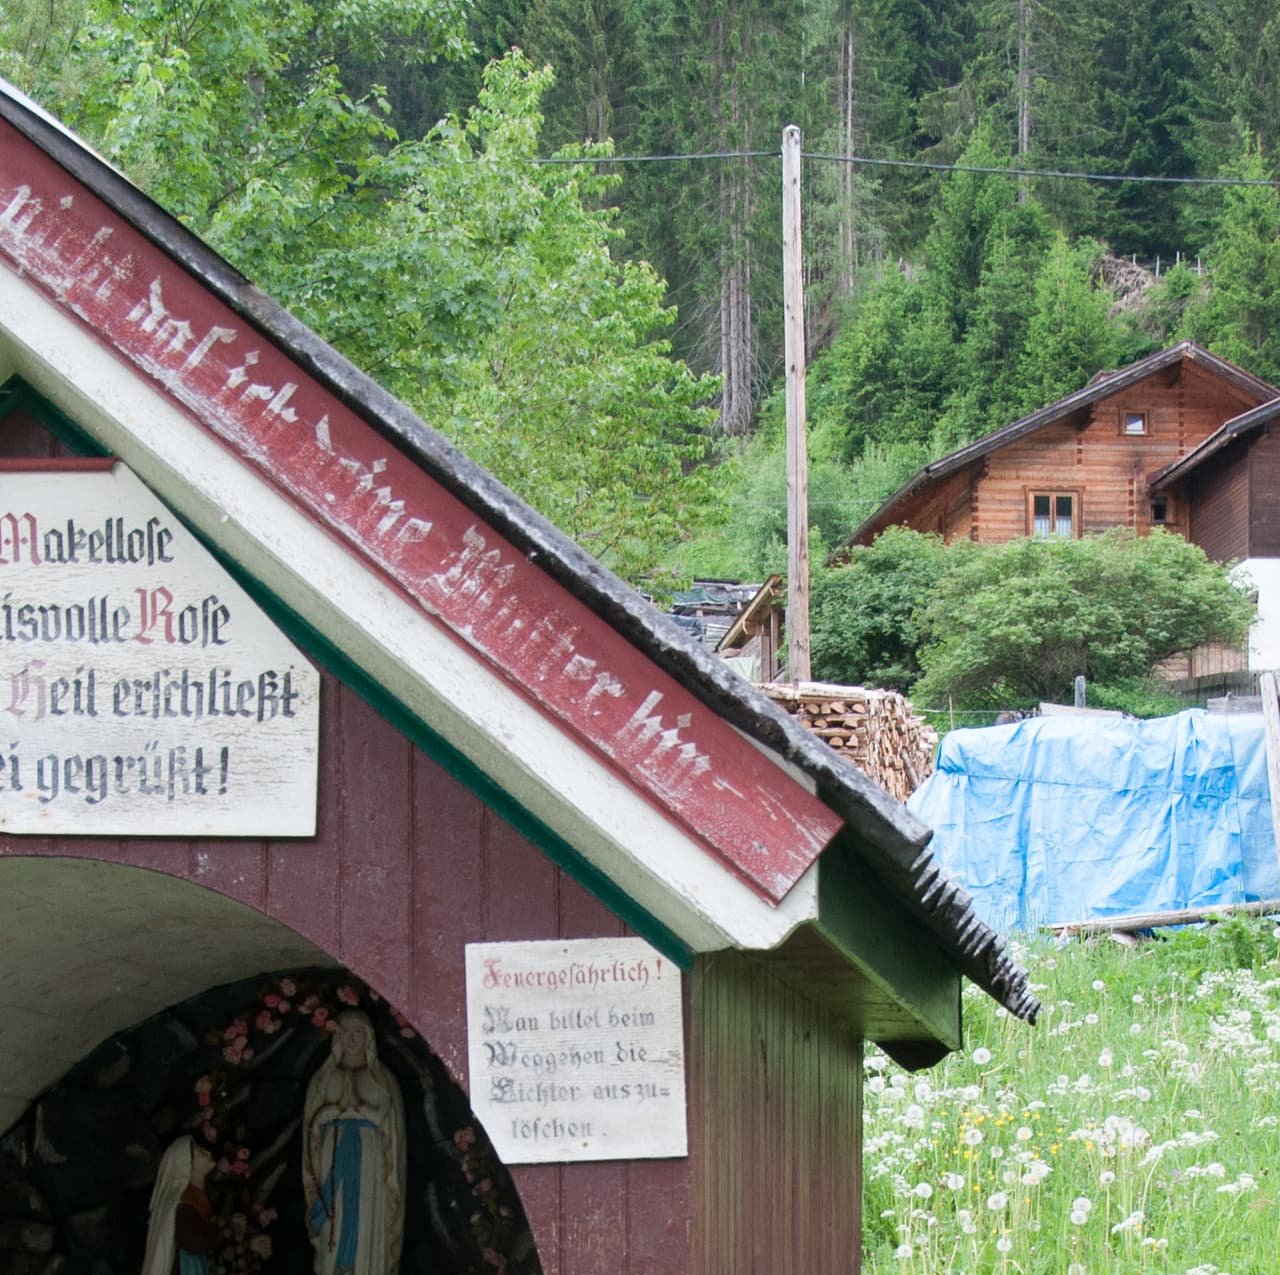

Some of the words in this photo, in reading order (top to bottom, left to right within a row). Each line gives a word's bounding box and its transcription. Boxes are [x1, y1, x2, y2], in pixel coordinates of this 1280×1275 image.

[134, 587, 230, 647] Rose
[428, 523, 626, 716] Mutter
[5, 660, 98, 721] Heil
[482, 1005, 538, 1035] Man
[549, 1008, 601, 1031] bittet
[608, 1006, 655, 1027] beim
[482, 1040, 604, 1073] Weggehen
[616, 1041, 648, 1063] die
[490, 1076, 580, 1106] Lichter
